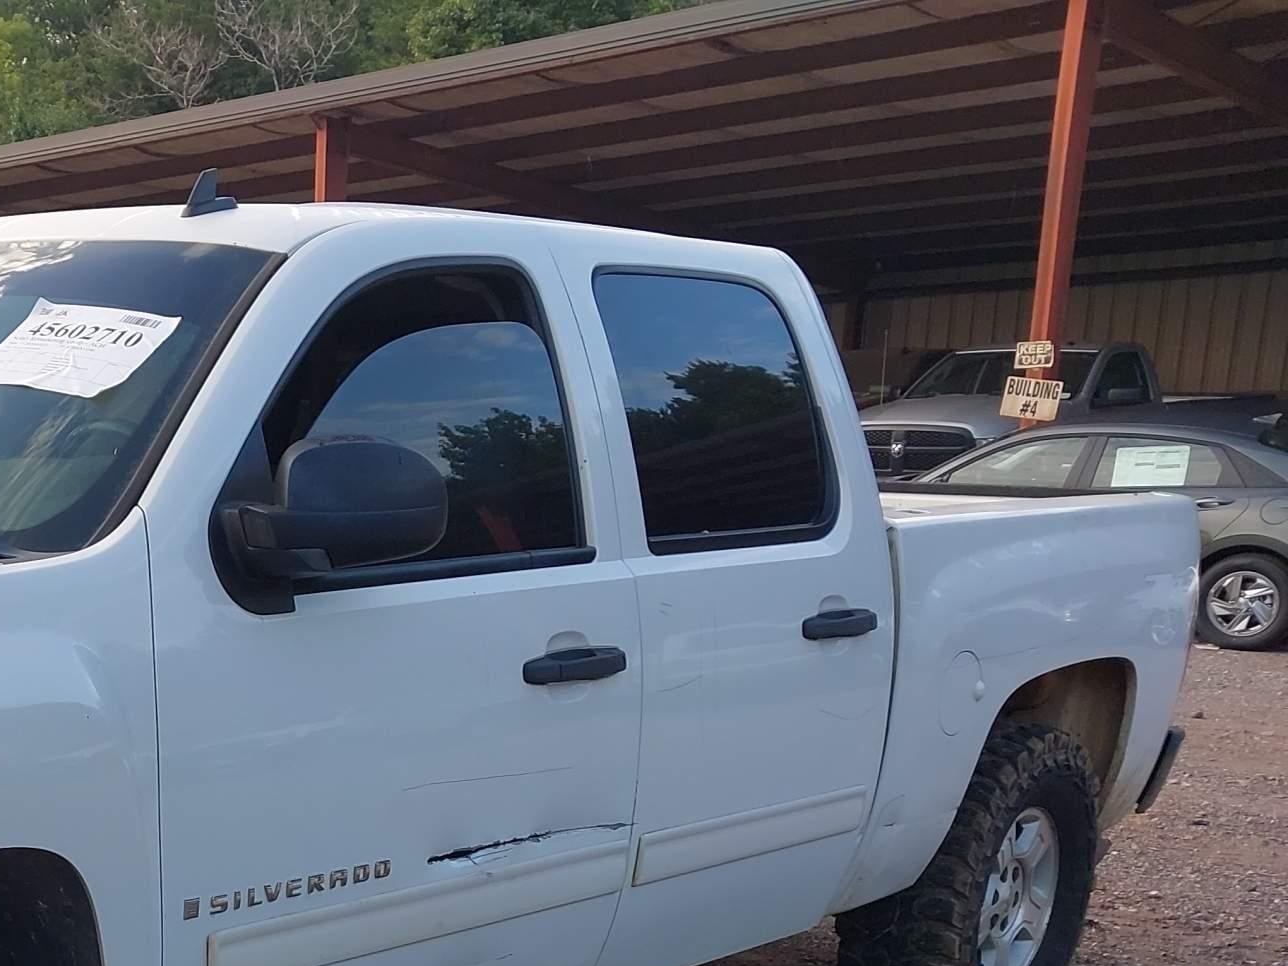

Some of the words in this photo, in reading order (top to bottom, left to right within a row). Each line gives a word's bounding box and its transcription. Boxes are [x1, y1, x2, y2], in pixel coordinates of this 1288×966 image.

[28, 321, 144, 348] 45602710
[1017, 343, 1052, 355] KEEP
[1021, 355, 1048, 365] OUT
[1007, 378, 1060, 400] BUILDING
[1019, 400, 1039, 417] #4
[209, 859, 392, 916] SILVERADO
